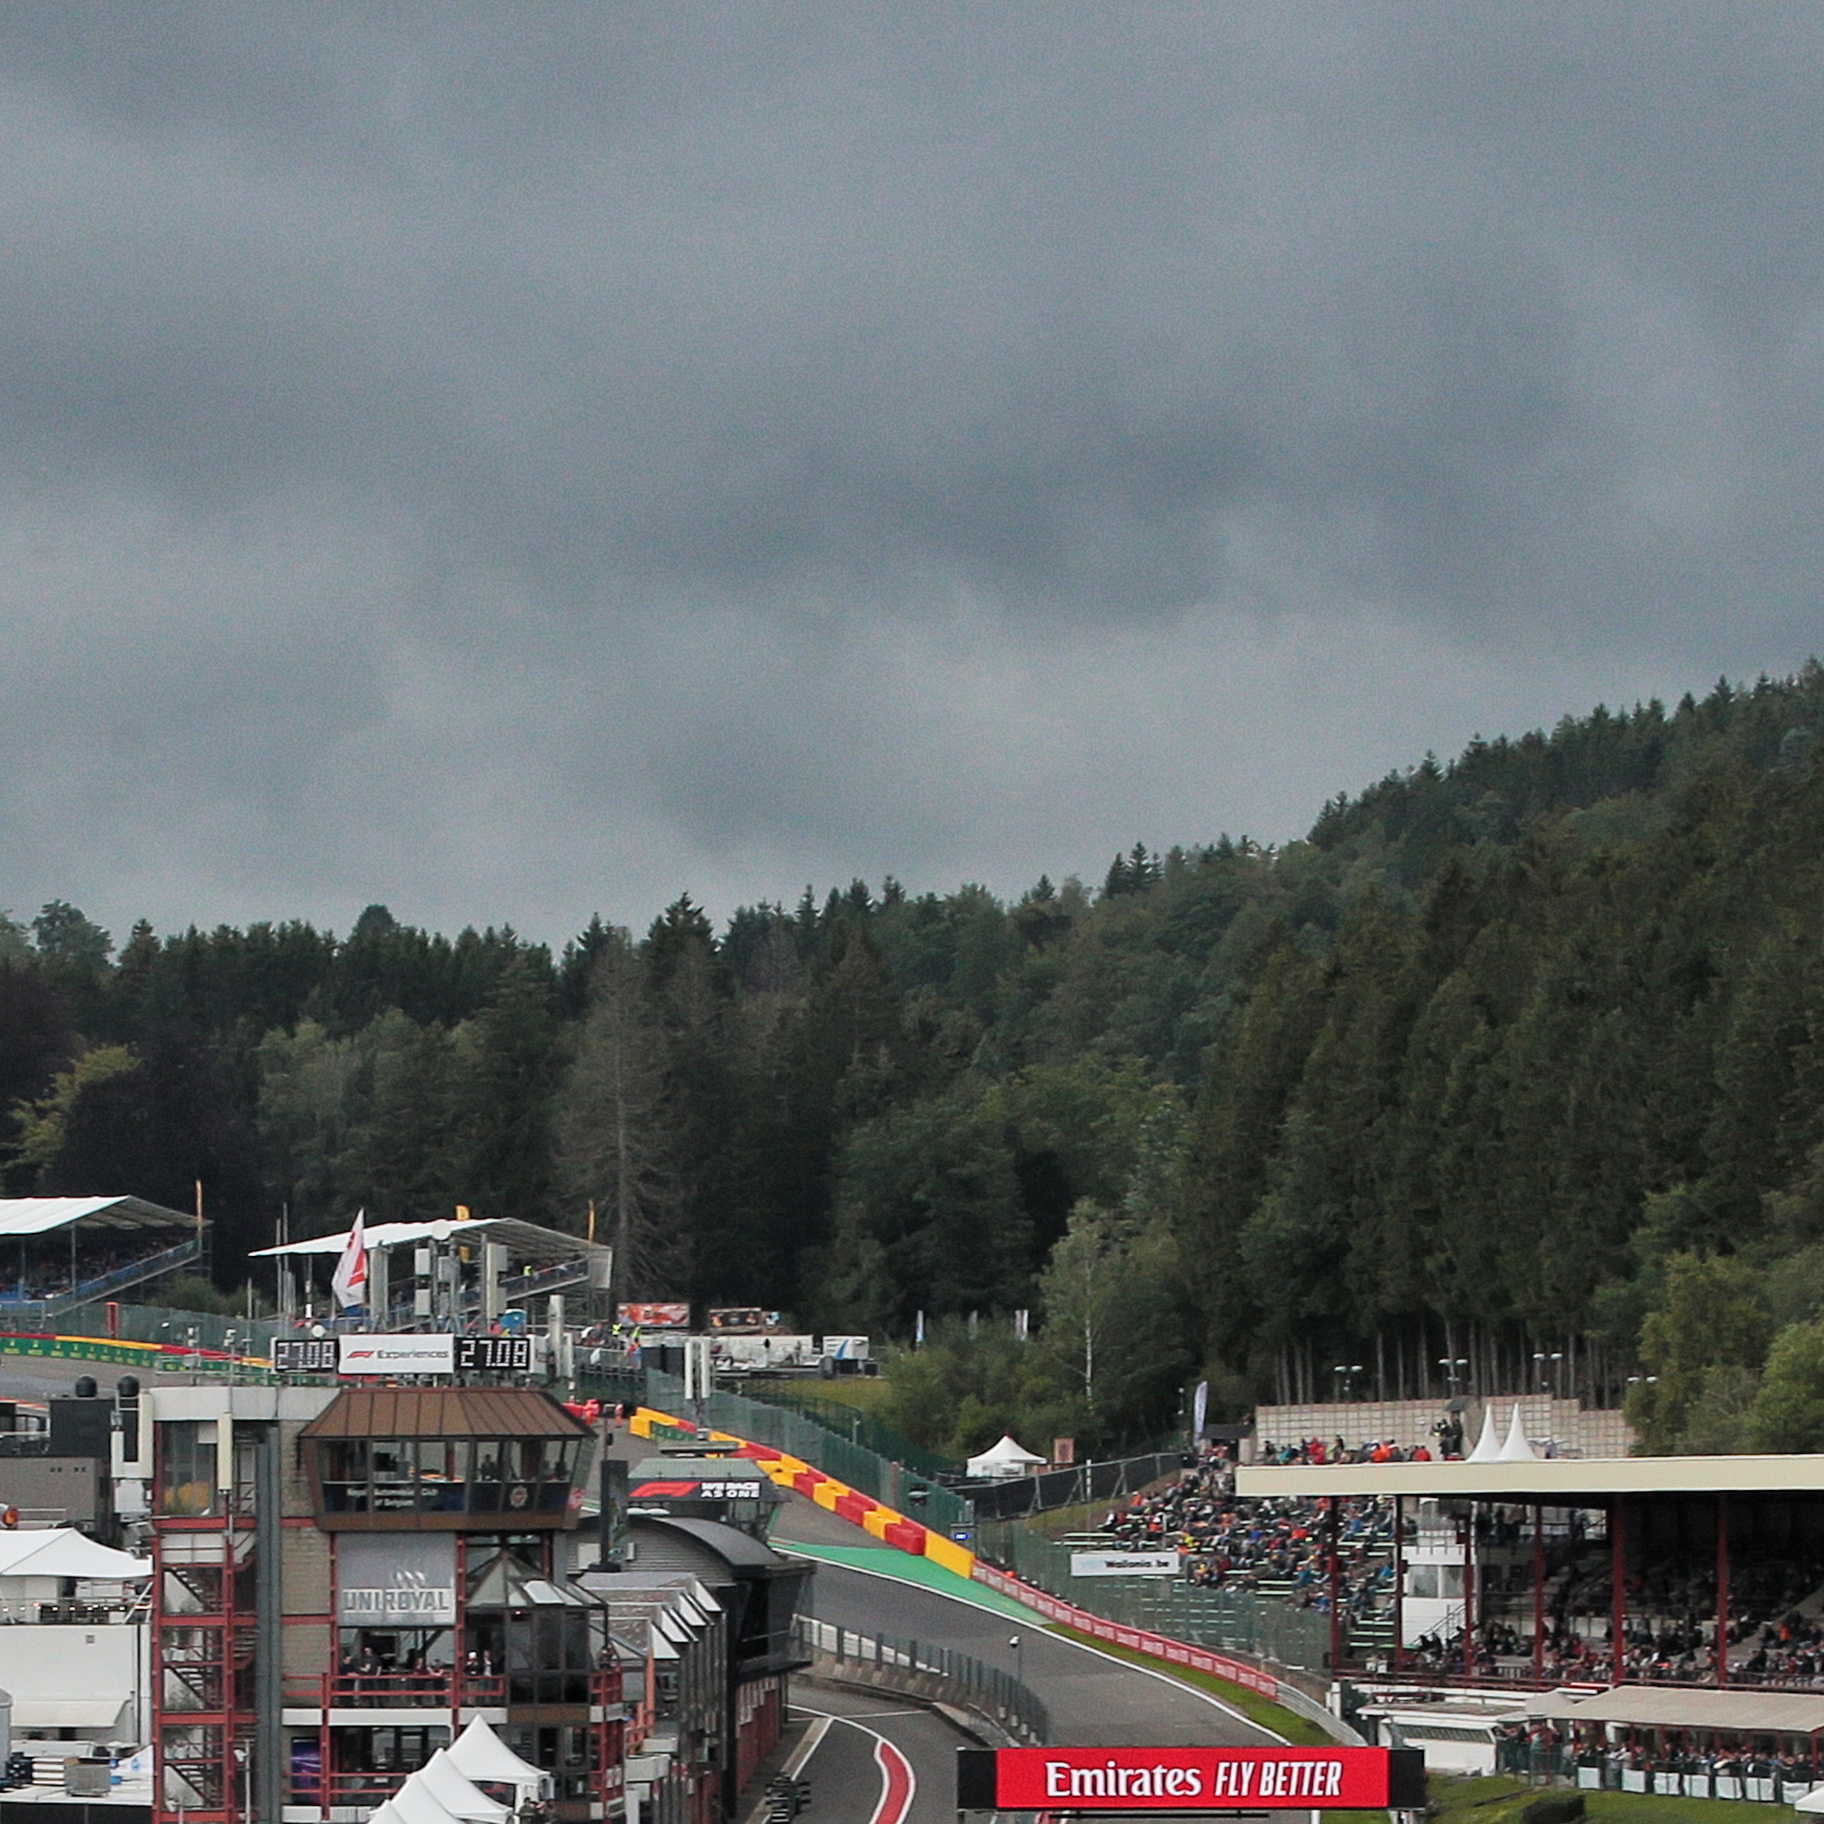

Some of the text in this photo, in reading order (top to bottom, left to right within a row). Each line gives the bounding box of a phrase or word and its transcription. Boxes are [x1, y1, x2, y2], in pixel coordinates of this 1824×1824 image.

[377, 1350, 450, 1361] Experiences
[461, 1340, 527, 1367] 27.08
[700, 1490, 760, 1498] AS ONE
[342, 1591, 451, 1611] UNIROYAL
[1044, 1760, 1343, 1797] Emirates FLY BETTER
